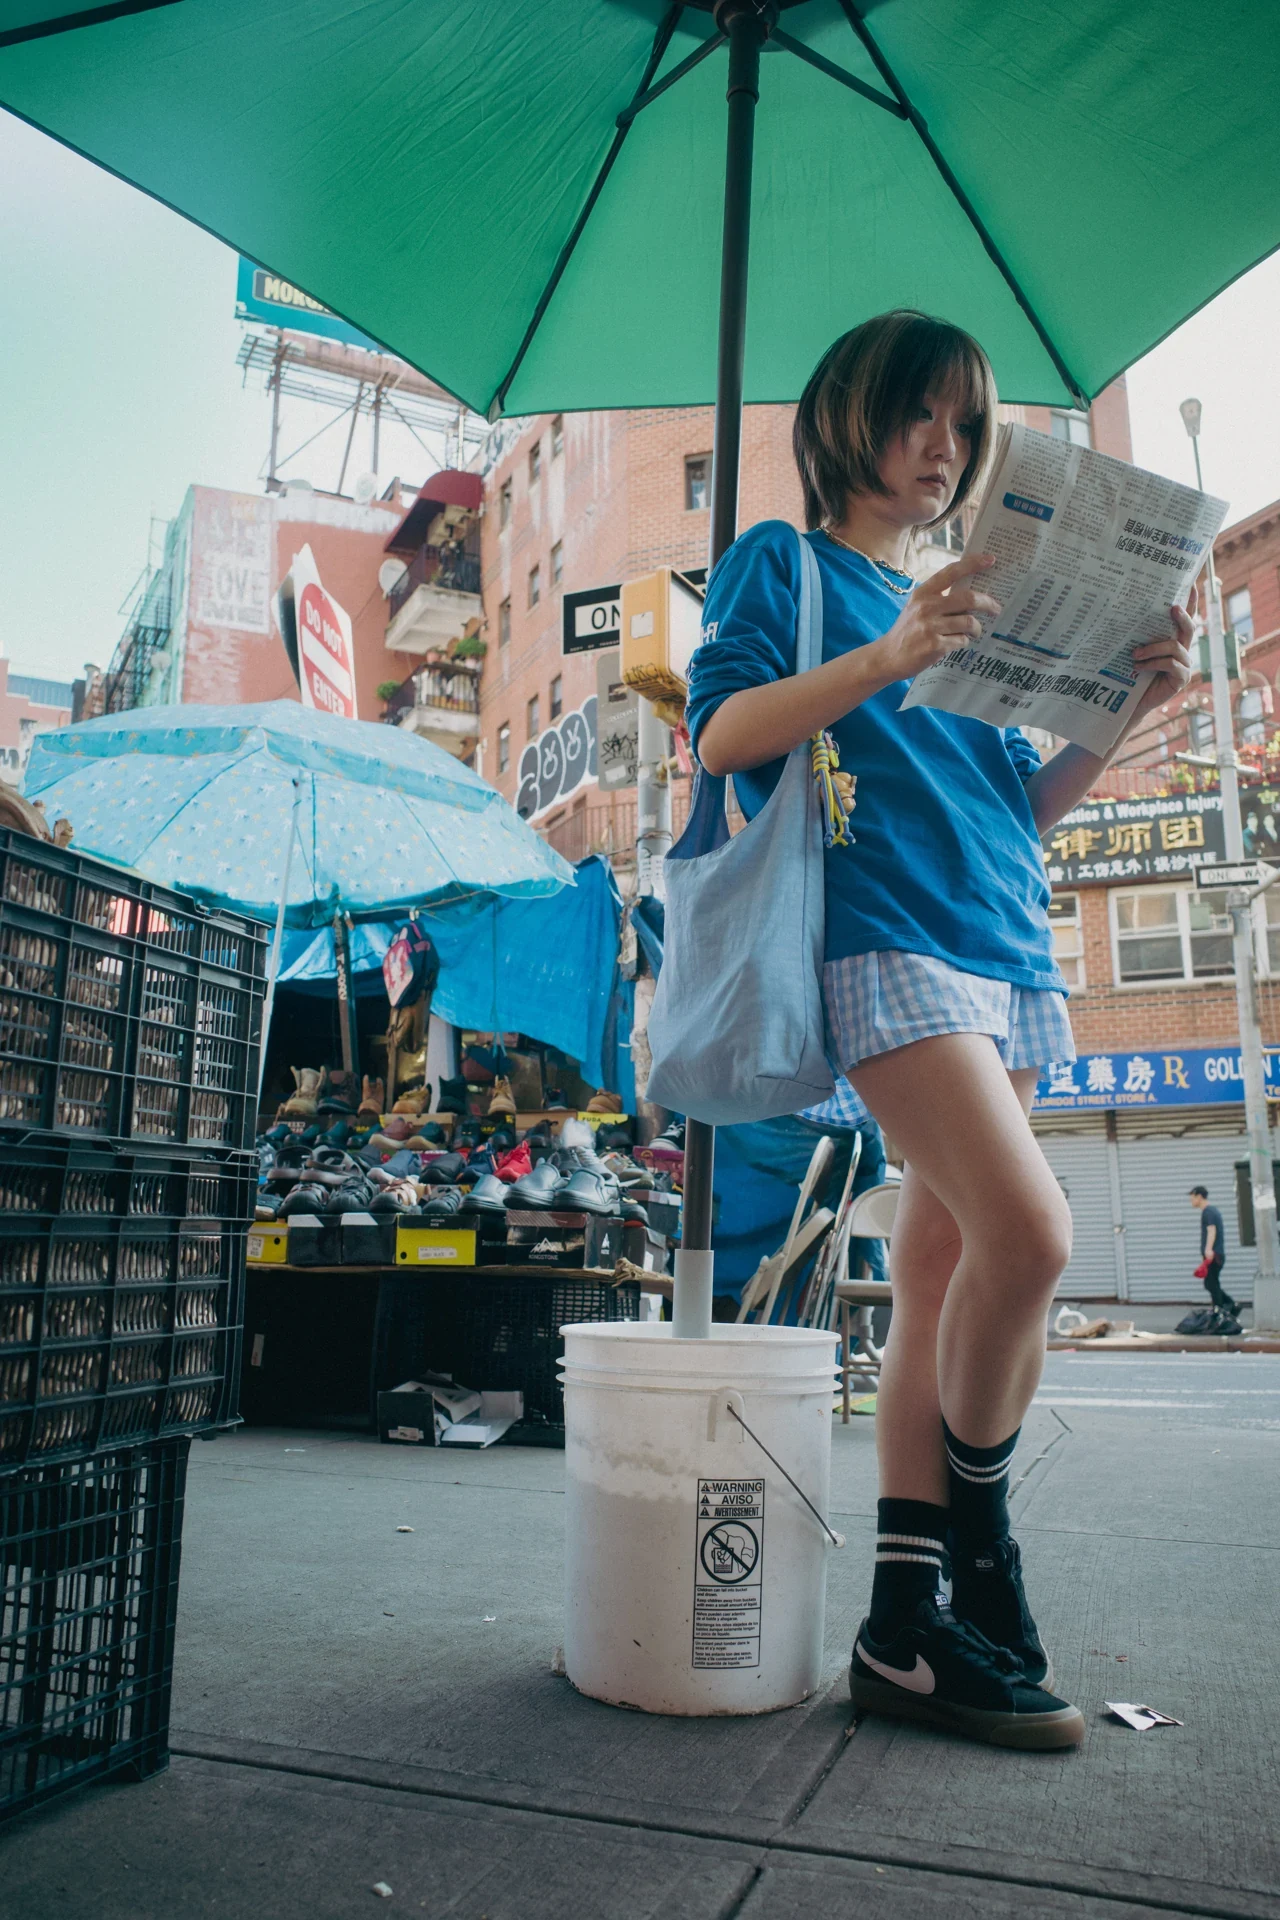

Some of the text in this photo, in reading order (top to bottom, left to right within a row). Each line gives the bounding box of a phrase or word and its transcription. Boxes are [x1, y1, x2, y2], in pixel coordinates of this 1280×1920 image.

[264, 276, 331, 313] MOR
[306, 600, 344, 657] DO NOT
[313, 672, 345, 717] ENTER
[1104, 804, 1114, 820] &
[1116, 800, 1184, 819] Workplace
[1186, 795, 1223, 813] Injury
[1044, 815, 1205, 863] 律师团
[1244, 868, 1268, 878] WAY
[1204, 1055, 1272, 1082] GOLN
[712, 1483, 762, 1492] WARNING
[721, 1495, 753, 1505] AVISO
[714, 1506, 759, 1516] AVERTISSEMENT
